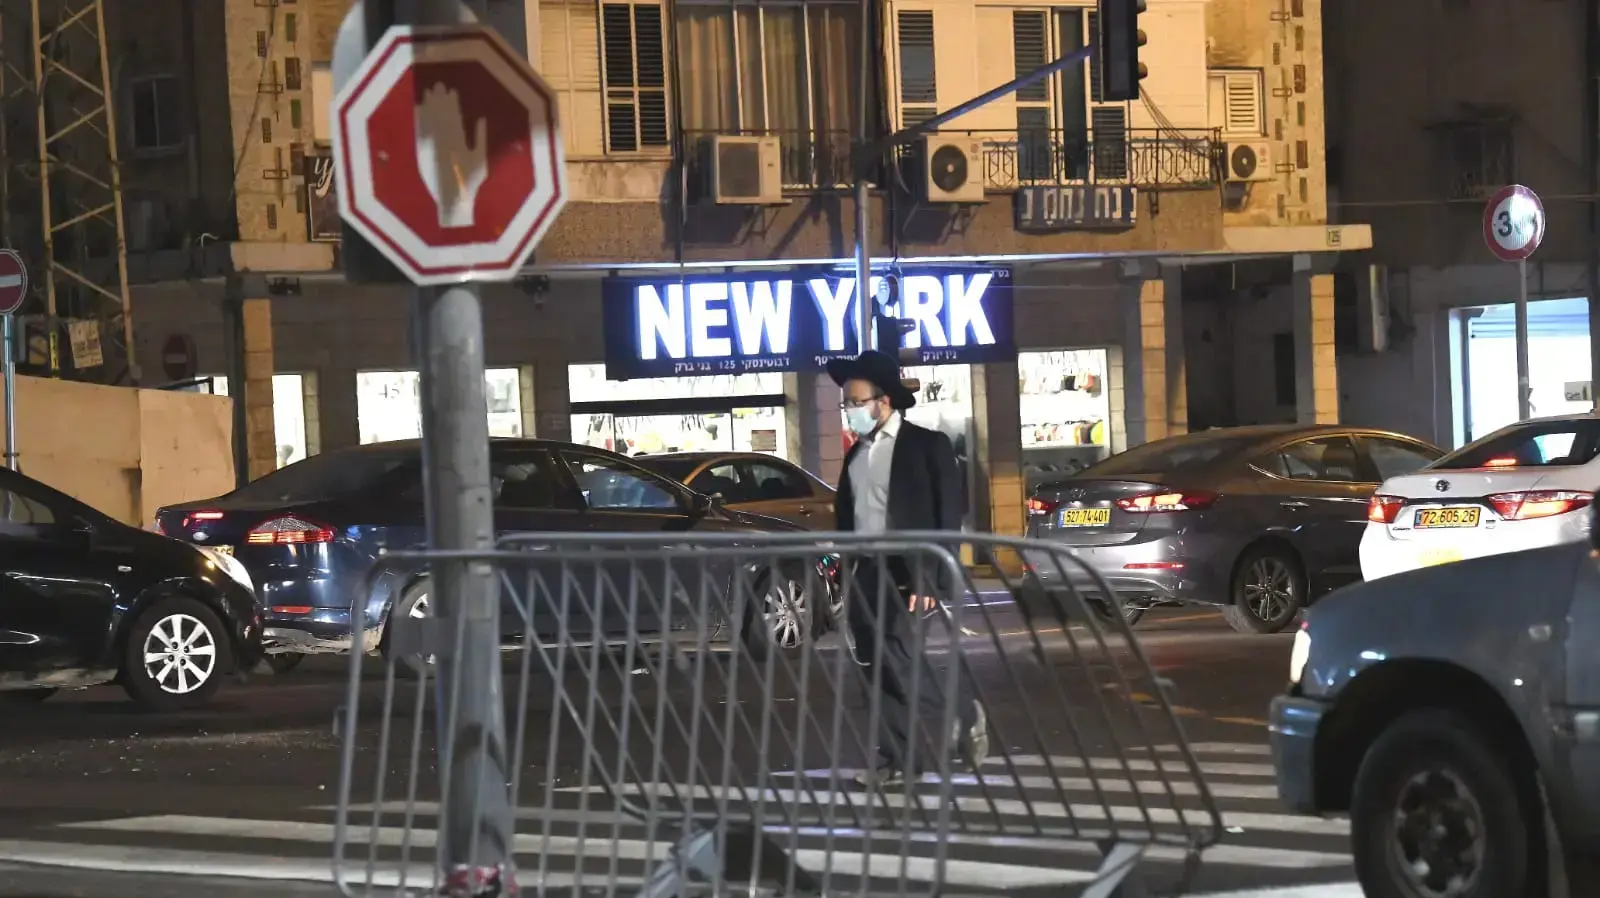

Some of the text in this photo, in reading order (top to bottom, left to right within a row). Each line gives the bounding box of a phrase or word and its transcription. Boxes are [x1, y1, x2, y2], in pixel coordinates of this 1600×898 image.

[635, 279, 793, 360] NEW
[674, 362, 694, 374] ברק
[697, 361, 711, 371] בני
[719, 360, 736, 370] 125
